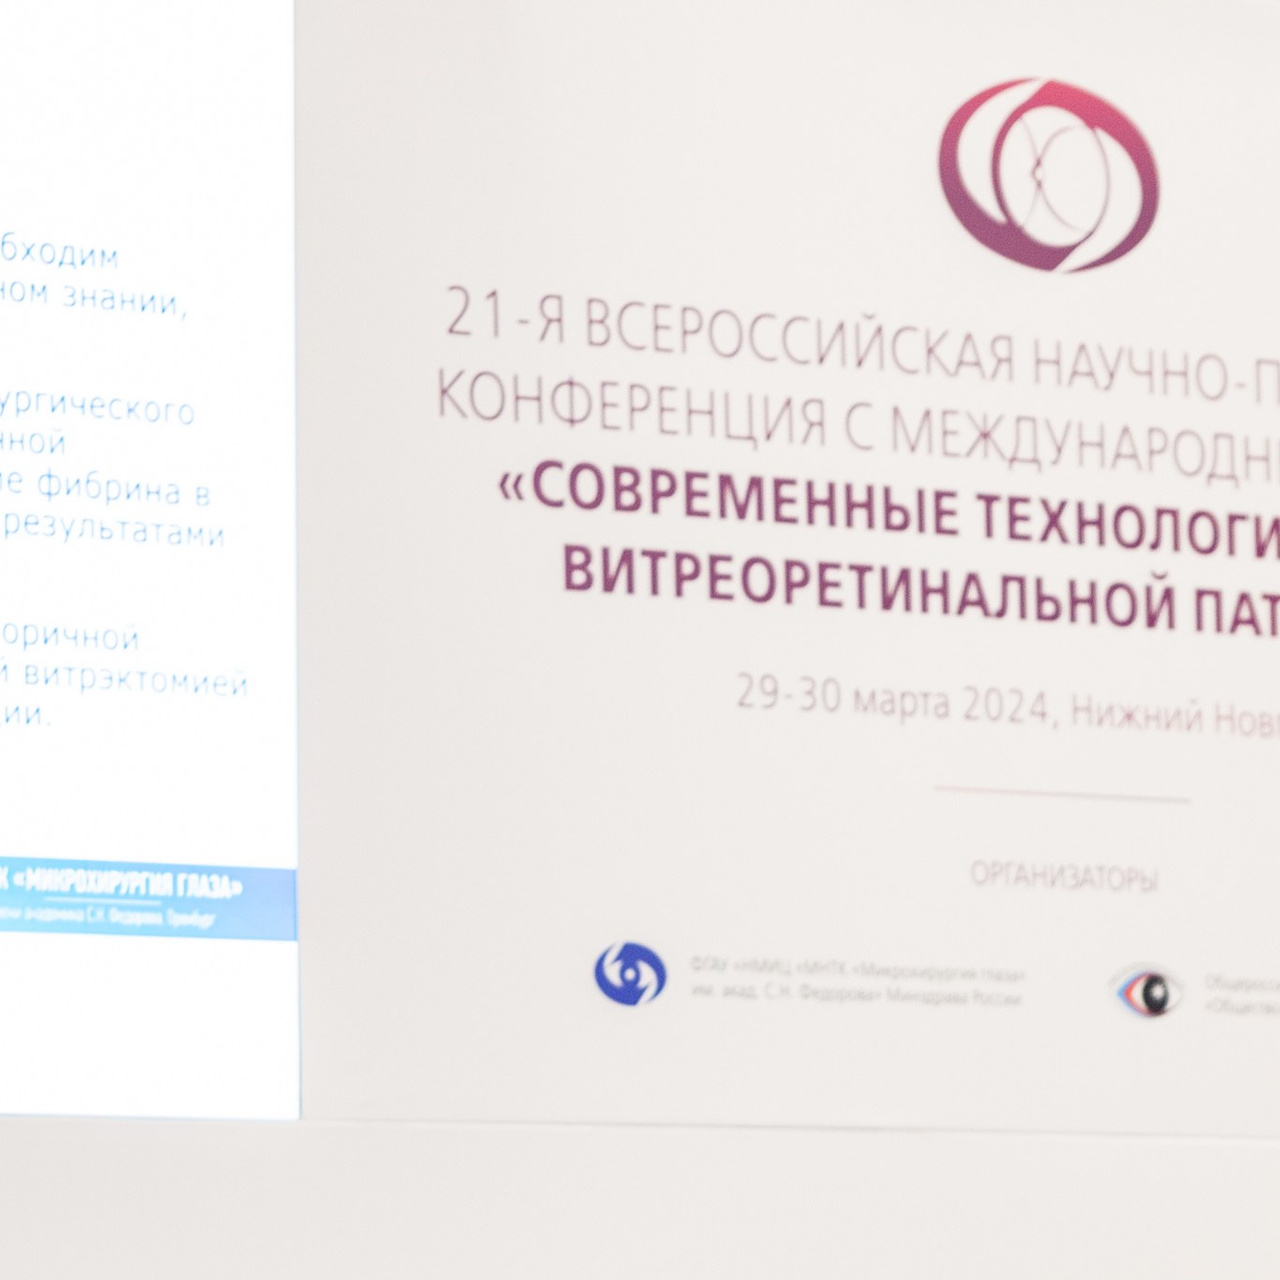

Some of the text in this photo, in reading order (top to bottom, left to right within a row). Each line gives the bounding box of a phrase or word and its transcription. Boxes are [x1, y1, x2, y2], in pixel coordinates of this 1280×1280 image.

[64, 285, 189, 322] знании,
[445, 283, 566, 345] 21-Я
[585, 296, 1015, 383] ВСЕРОССИЙСКАЯ
[436, 366, 1280, 490] КОНФЕРЕНЦИЯ С МЕЖДУНАРОДН
[37, 468, 180, 506] фибрина
[196, 486, 210, 507] в
[498, 459, 959, 537] «СОВРЕМЕННЫЕ
[4, 513, 224, 547] результатами
[563, 543, 1176, 631] ВИТРЕОРЕТИНАЛЬНОЙ
[24, 664, 247, 696] витрэктомией
[735, 670, 1280, 741] 29-30 марта 2024, Нижний Нов
